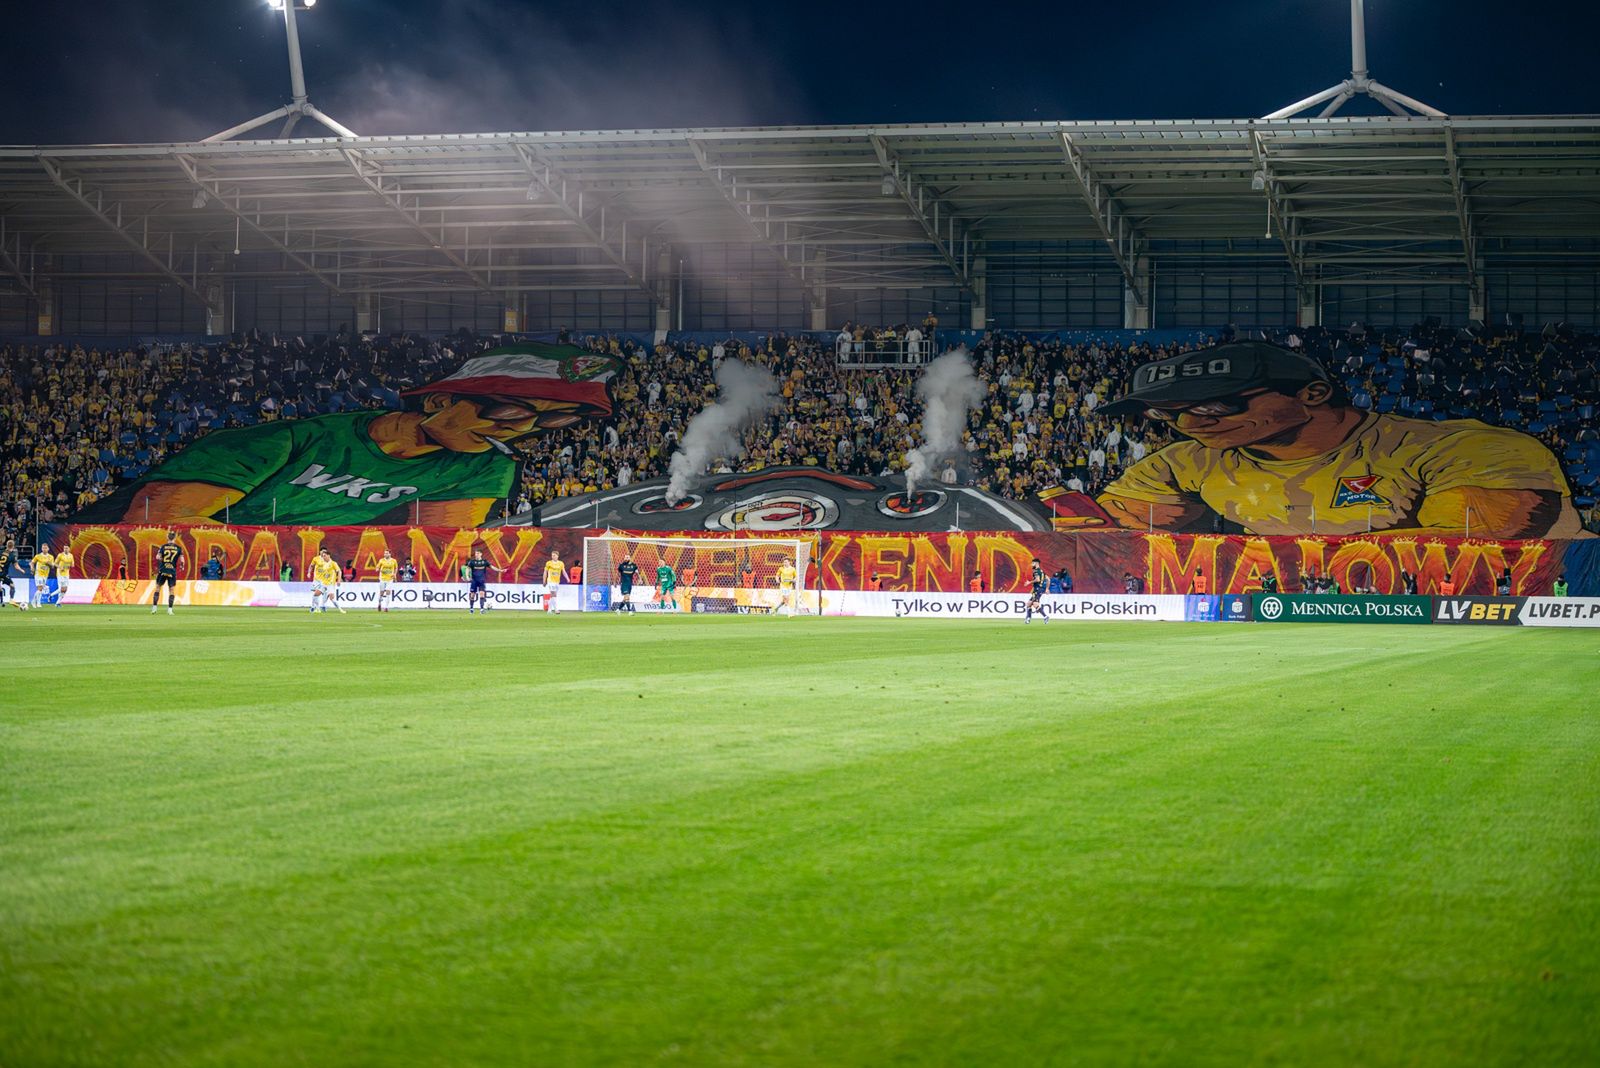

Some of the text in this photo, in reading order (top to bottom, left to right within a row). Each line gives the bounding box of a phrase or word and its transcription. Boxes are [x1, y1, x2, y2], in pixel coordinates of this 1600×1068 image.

[1146, 358, 1231, 383] 1950
[288, 463, 418, 503] WKS
[1347, 493, 1376, 501] MOTOR
[163, 550, 178, 563] 27
[390, 589, 418, 602] KO
[892, 599, 1157, 615] Tylko w PKO Bnku Polskim
[1291, 601, 1424, 617] MENNICA POLSKA
[1528, 602, 1600, 620] LVBET.P
